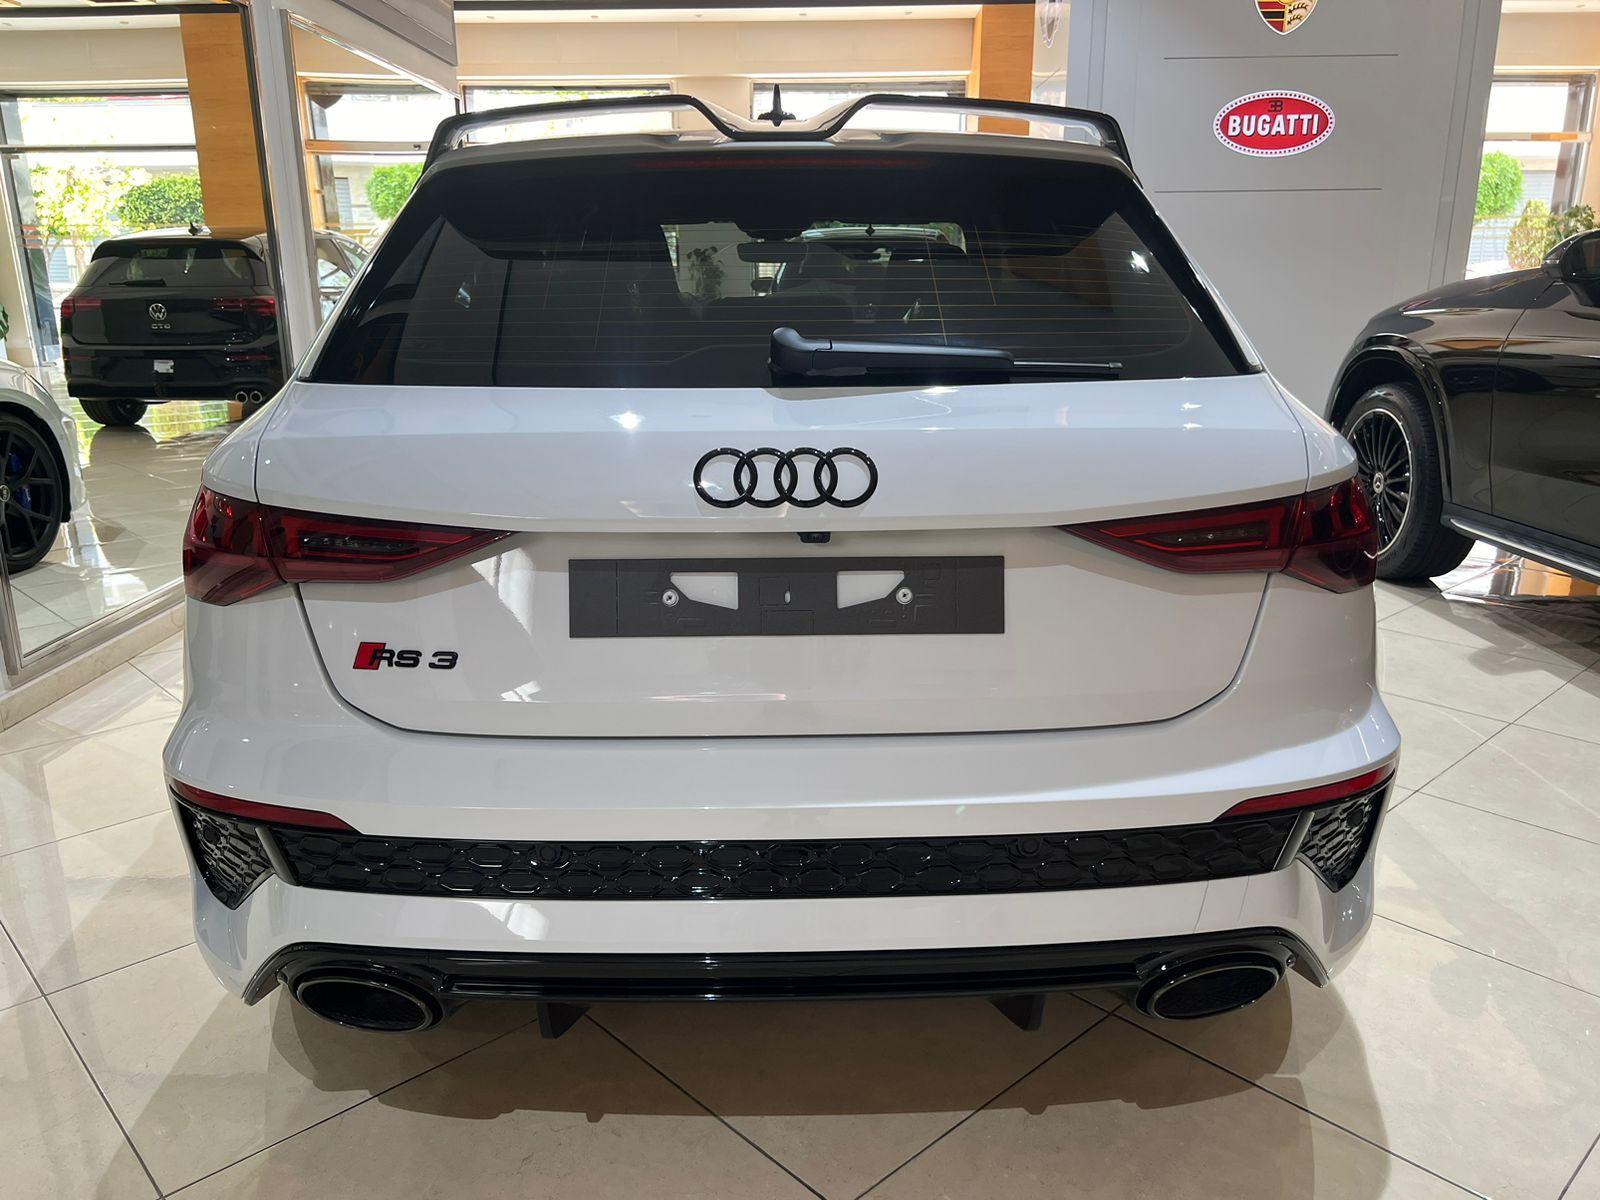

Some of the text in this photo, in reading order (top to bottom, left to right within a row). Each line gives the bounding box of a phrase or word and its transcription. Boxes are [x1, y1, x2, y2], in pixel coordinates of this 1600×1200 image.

[1227, 113, 1320, 136] BUGATTI
[366, 647, 459, 670] RS 3
